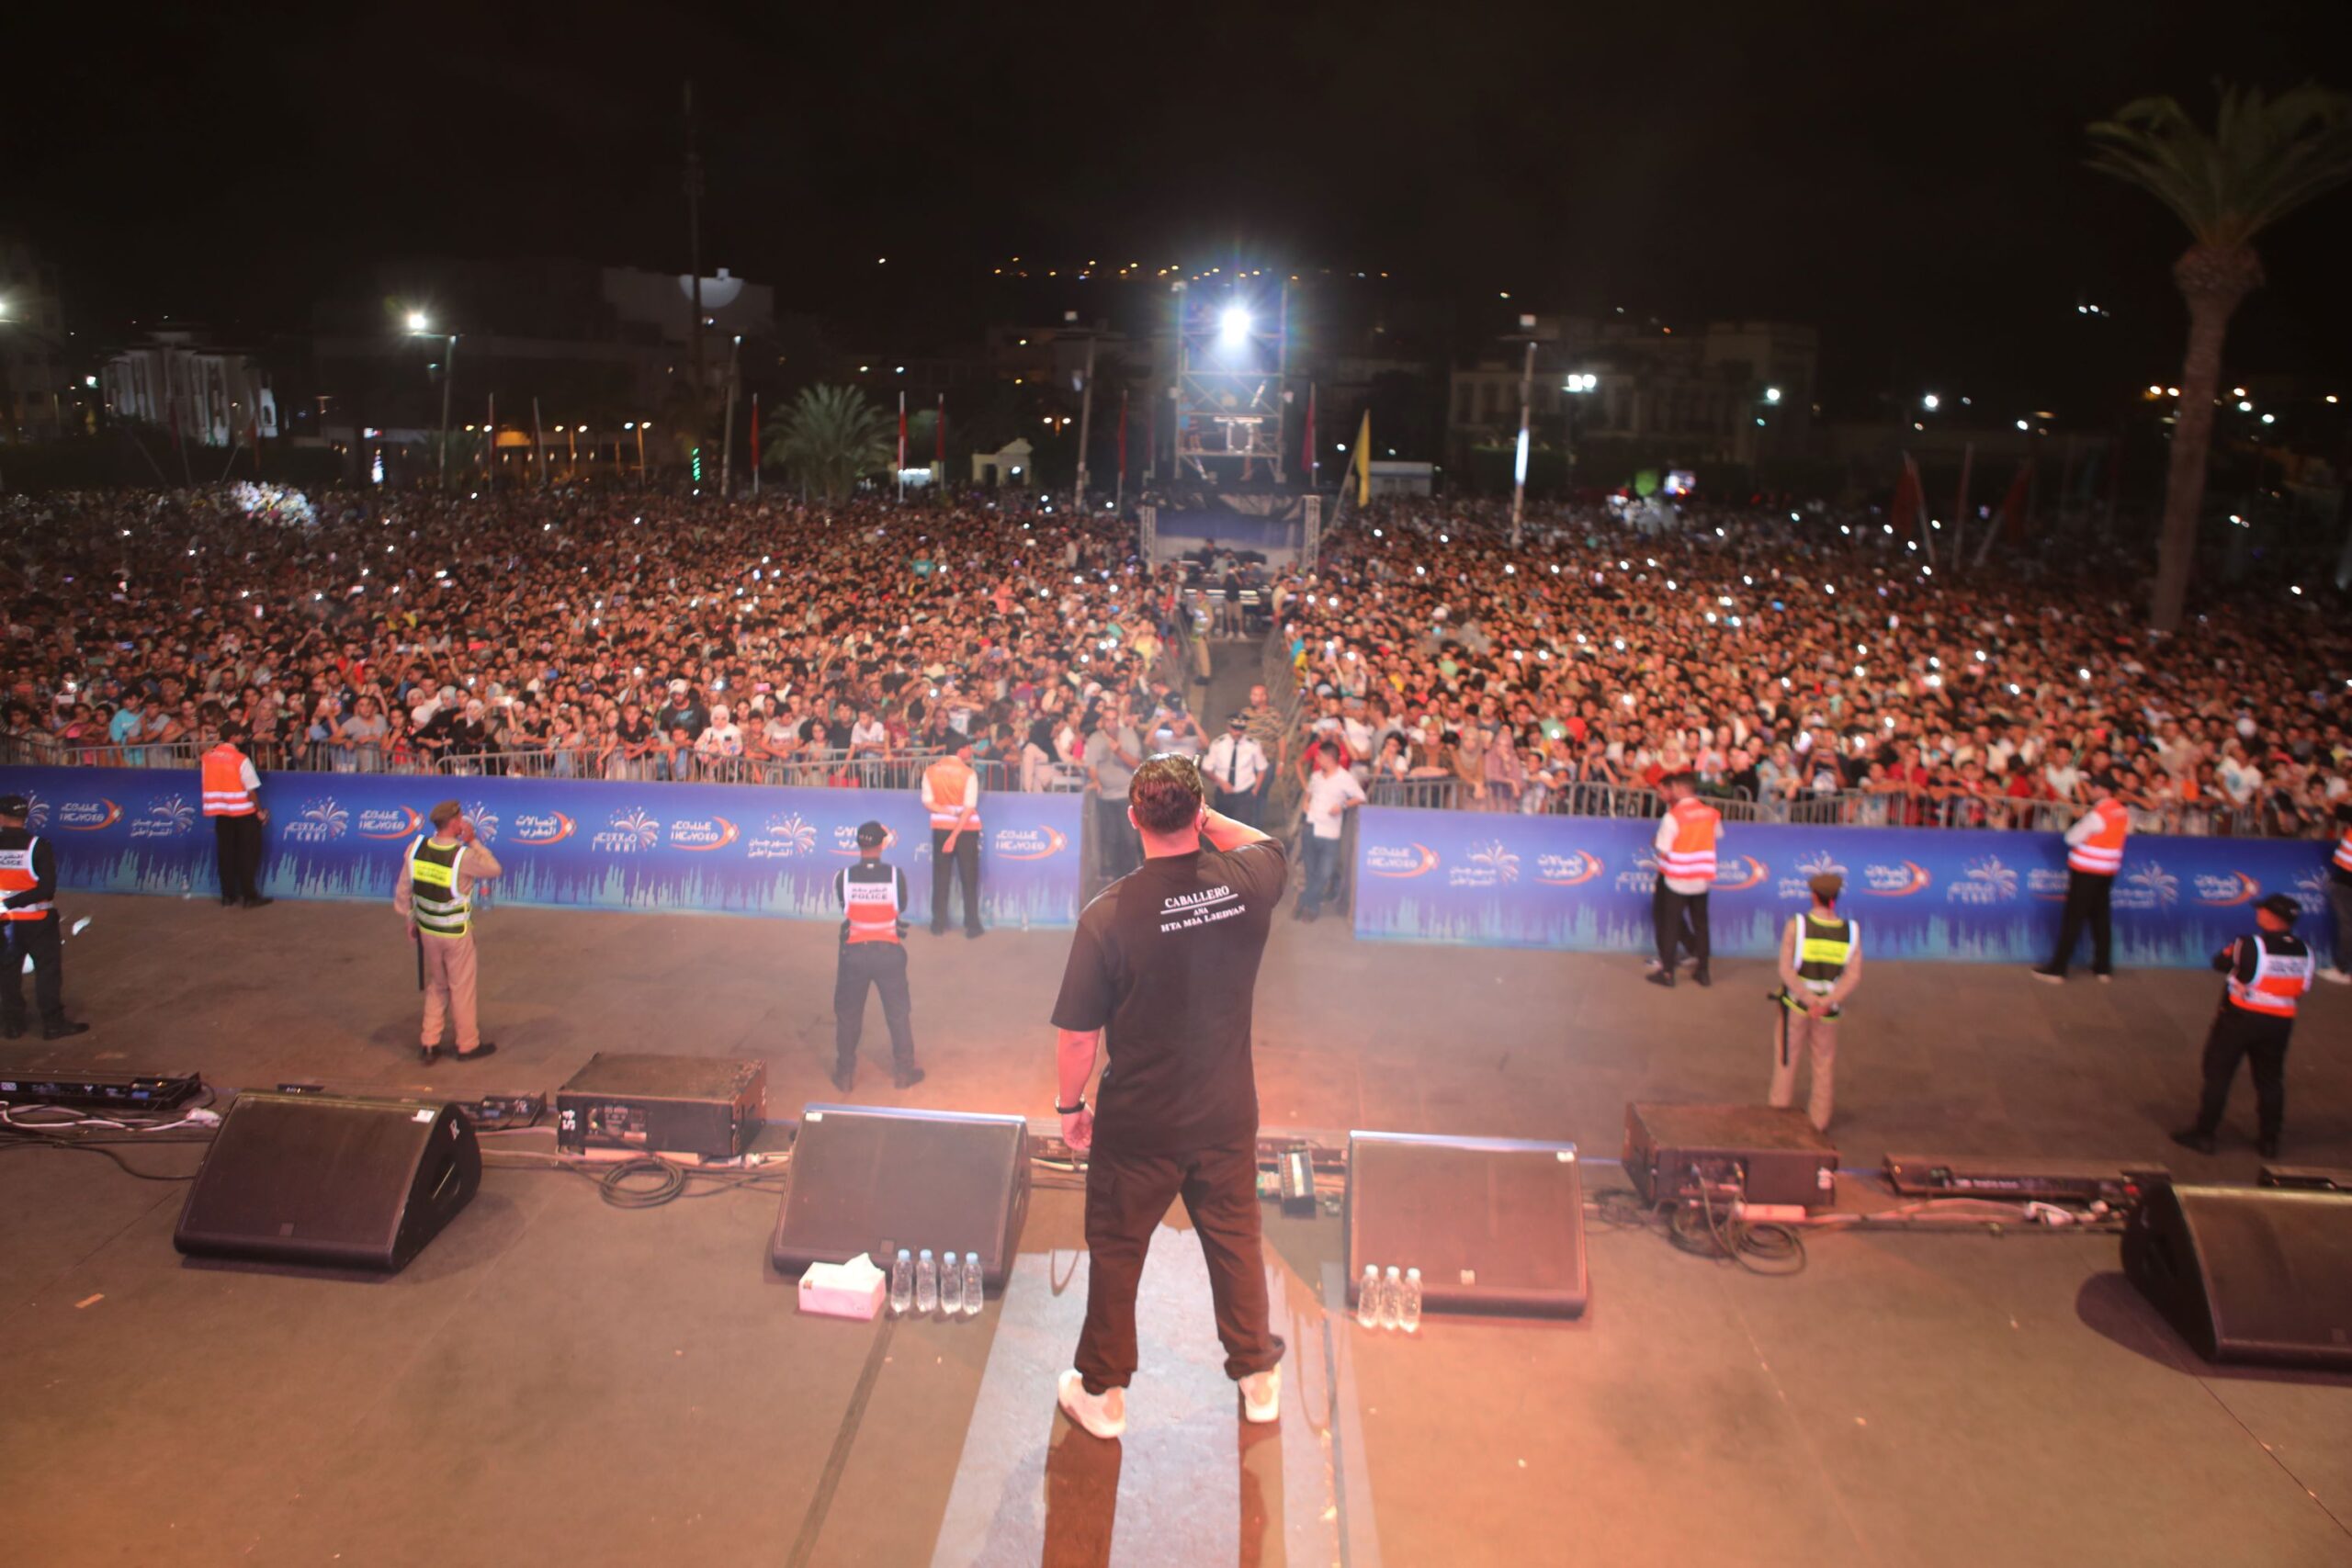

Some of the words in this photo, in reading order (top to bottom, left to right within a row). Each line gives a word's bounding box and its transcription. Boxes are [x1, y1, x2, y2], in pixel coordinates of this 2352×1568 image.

[515, 815, 558, 827] اتصالات
[520, 827, 557, 839] المغرب
[749, 838, 793, 848] مهرجان
[1164, 886, 1230, 908] CABALLERO
[1193, 907, 1209, 916] ANA
[1160, 922, 1182, 932] HTA
